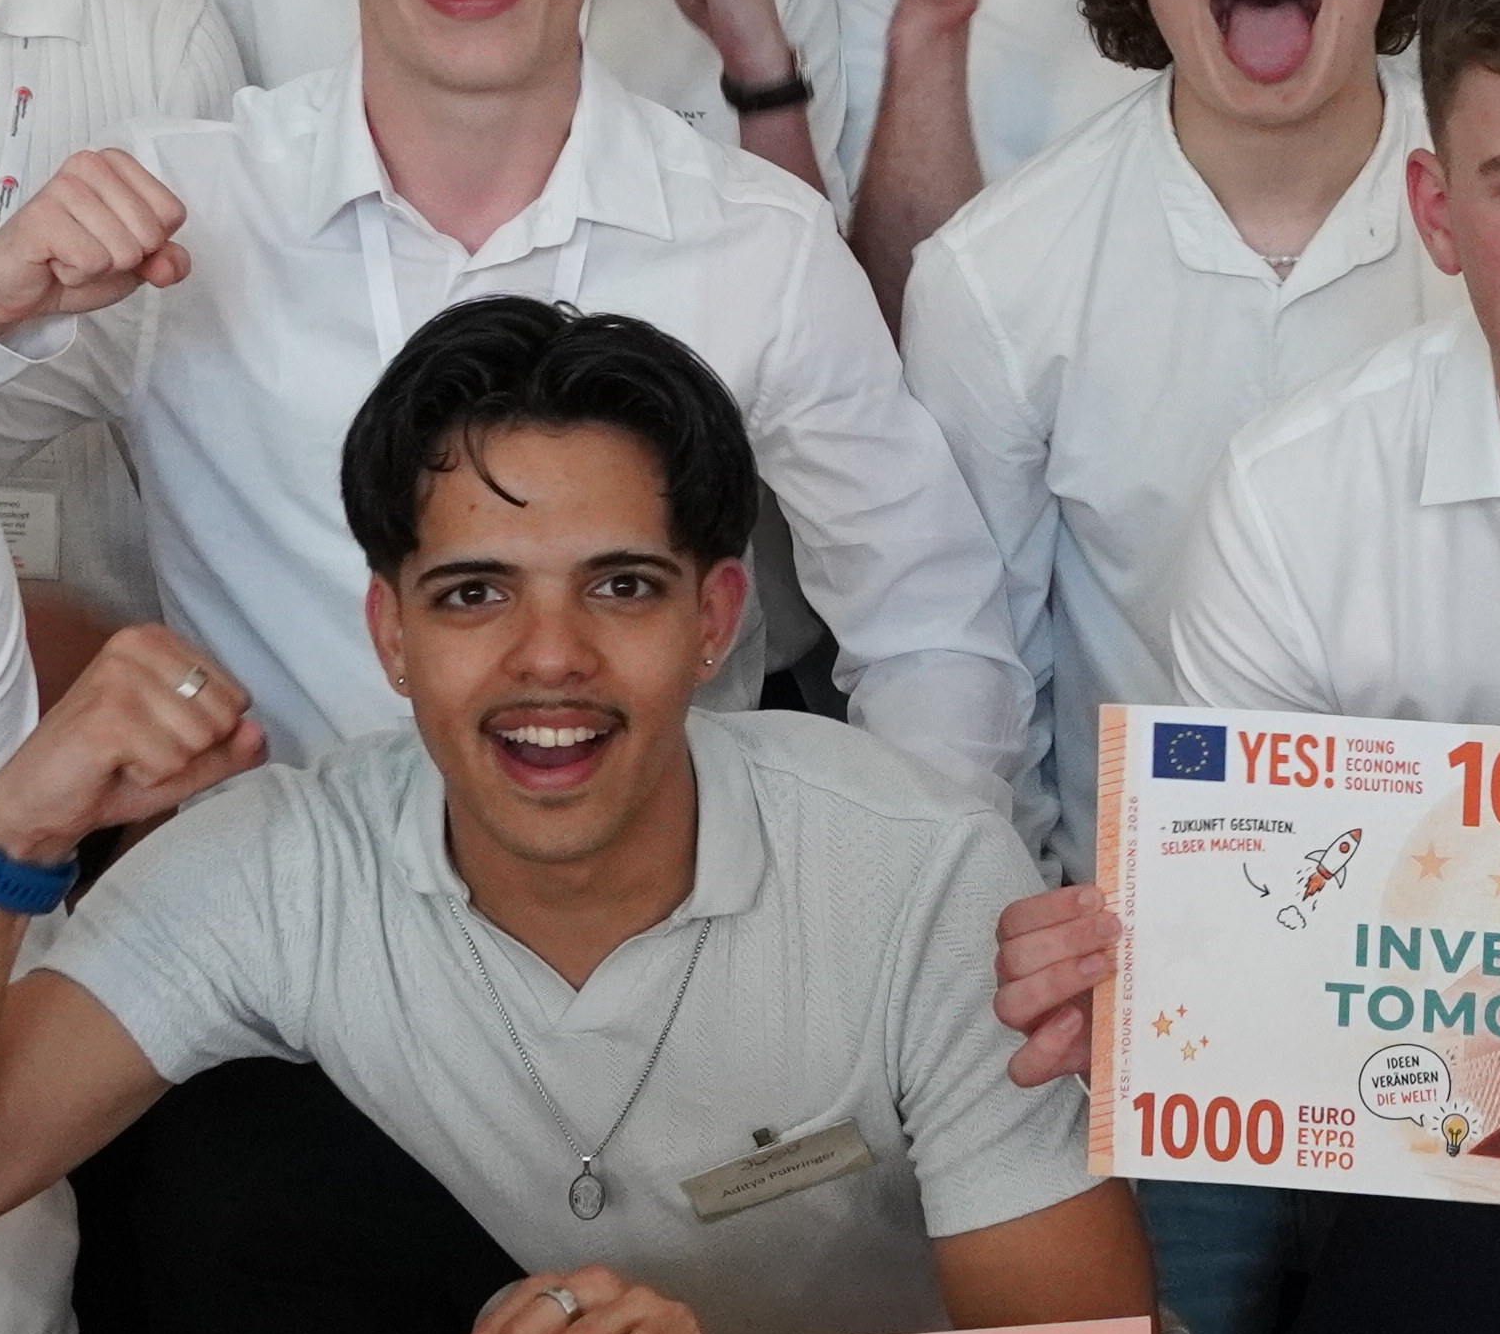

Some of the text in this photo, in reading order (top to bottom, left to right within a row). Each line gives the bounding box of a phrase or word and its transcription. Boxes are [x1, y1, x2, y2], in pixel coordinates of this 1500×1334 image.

[1345, 738, 1395, 755] YOUNG
[1237, 731, 1336, 789] YES!
[1345, 758, 1421, 776] ECONOMIC
[1344, 776, 1424, 795] SOLUTIONS
[1171, 817, 1297, 835] ZUKUNFT GESTALTEN.
[1161, 838, 1266, 856] SELBER MACHEN.
[1125, 839, 1138, 917] SOLUTIONS
[1121, 1006, 1132, 1056] YOUNG
[1386, 1055, 1420, 1070] IDEEN
[1371, 1070, 1439, 1089] VERÄNDERN
[1377, 1088, 1437, 1107] DIE WELT!
[1299, 1105, 1356, 1126] EURO
[1132, 1091, 1285, 1166] 1000
